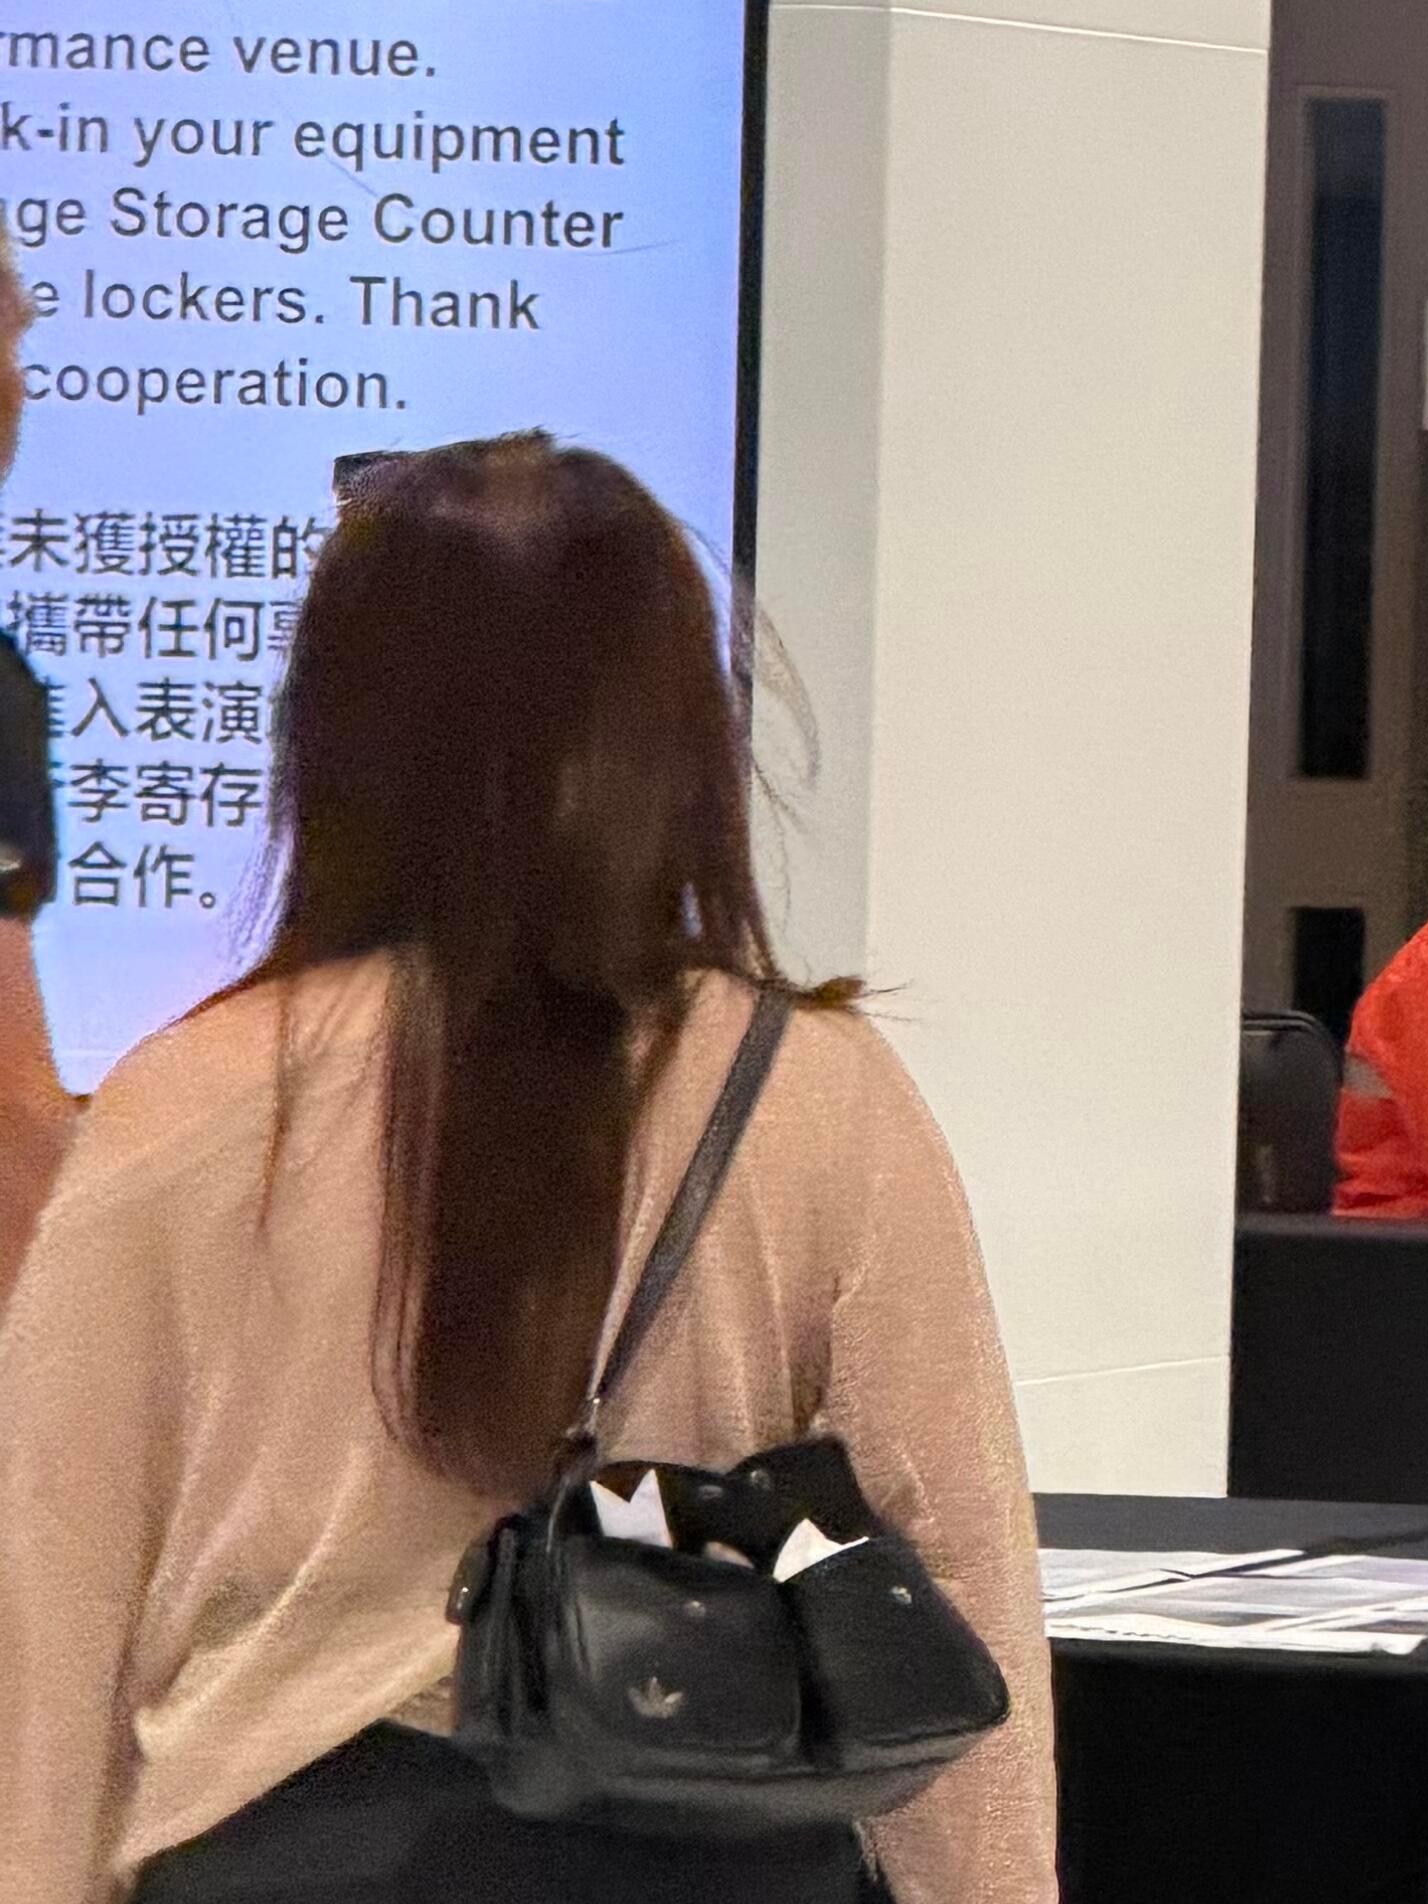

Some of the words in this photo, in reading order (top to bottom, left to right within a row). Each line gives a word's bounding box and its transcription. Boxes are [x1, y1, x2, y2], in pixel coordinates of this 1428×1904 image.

[0, 31, 210, 72] mance
[233, 36, 435, 77] venue.
[0, 101, 108, 153] k-in
[134, 117, 274, 168] your
[294, 110, 625, 173] equipment
[111, 187, 348, 254] Storage
[375, 193, 624, 248] Counter
[85, 269, 323, 324] lockers.
[349, 276, 539, 329] Thank
[24, 357, 405, 416] cooperation.
[0, 508, 330, 579] 未獲授權的
[50, 758, 264, 827] 李寄存
[67, 840, 216, 908] 合作。
